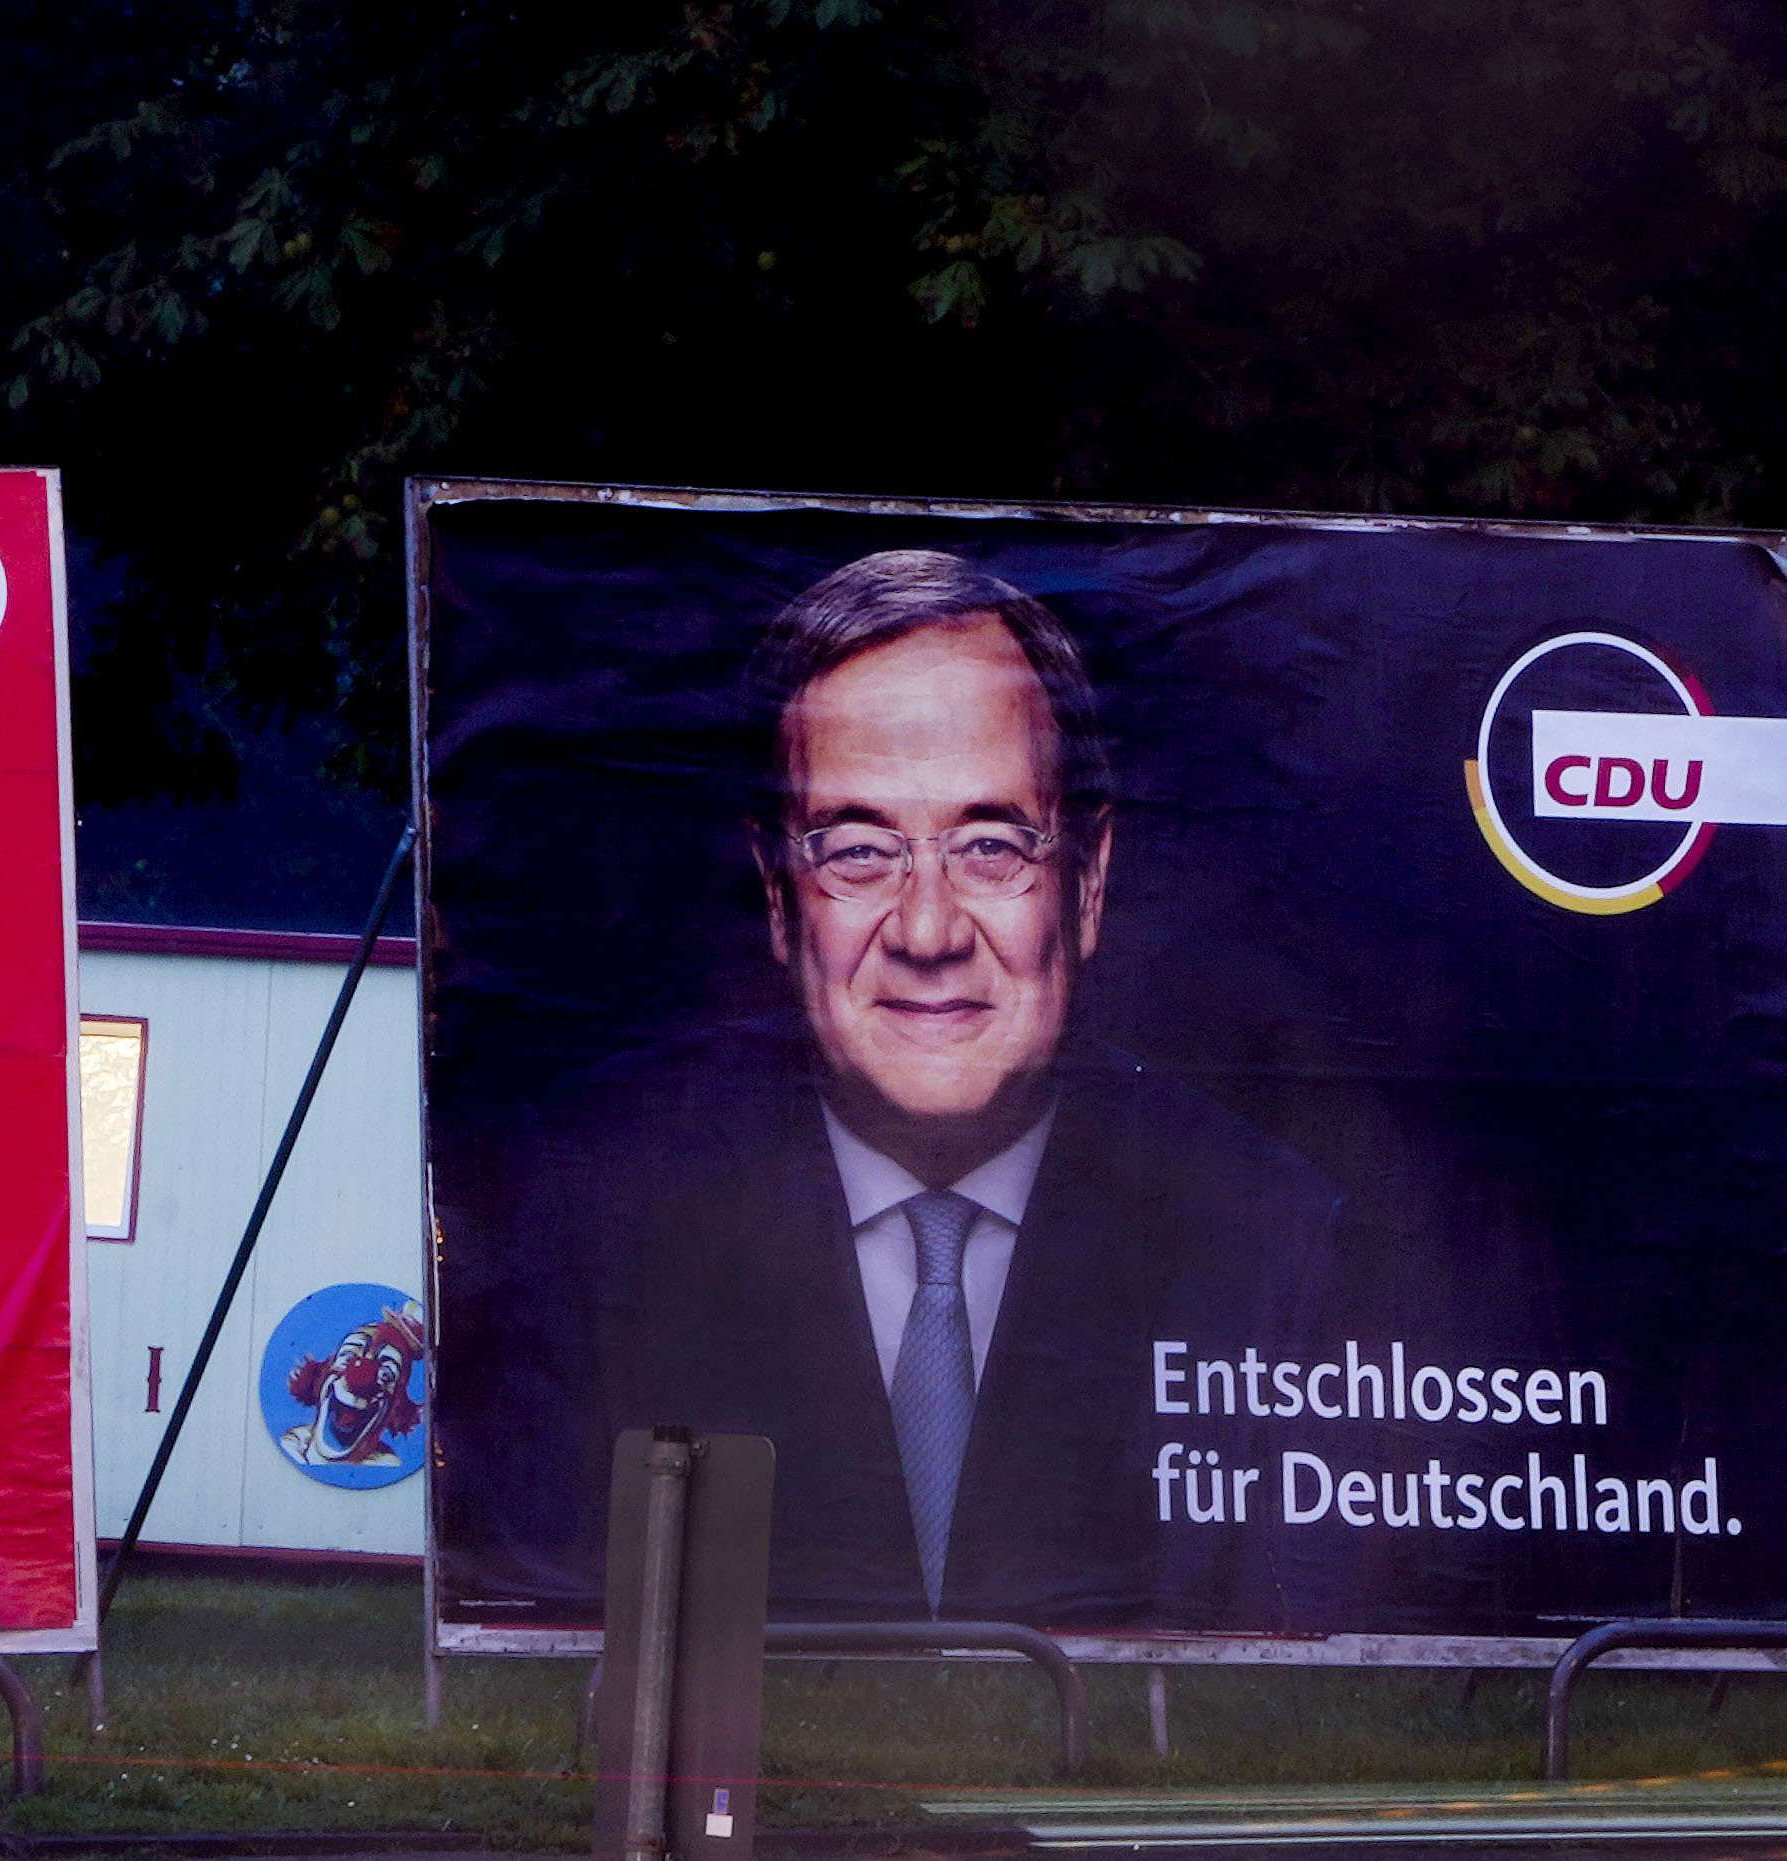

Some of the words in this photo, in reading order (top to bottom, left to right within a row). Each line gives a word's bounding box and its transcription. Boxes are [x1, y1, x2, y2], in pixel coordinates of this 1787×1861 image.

[1544, 755, 1703, 810] CDU
[1152, 1340, 1607, 1425] Entschlossen
[1152, 1443, 1260, 1523] für
[1282, 1451, 1742, 1536] Deutschland.
